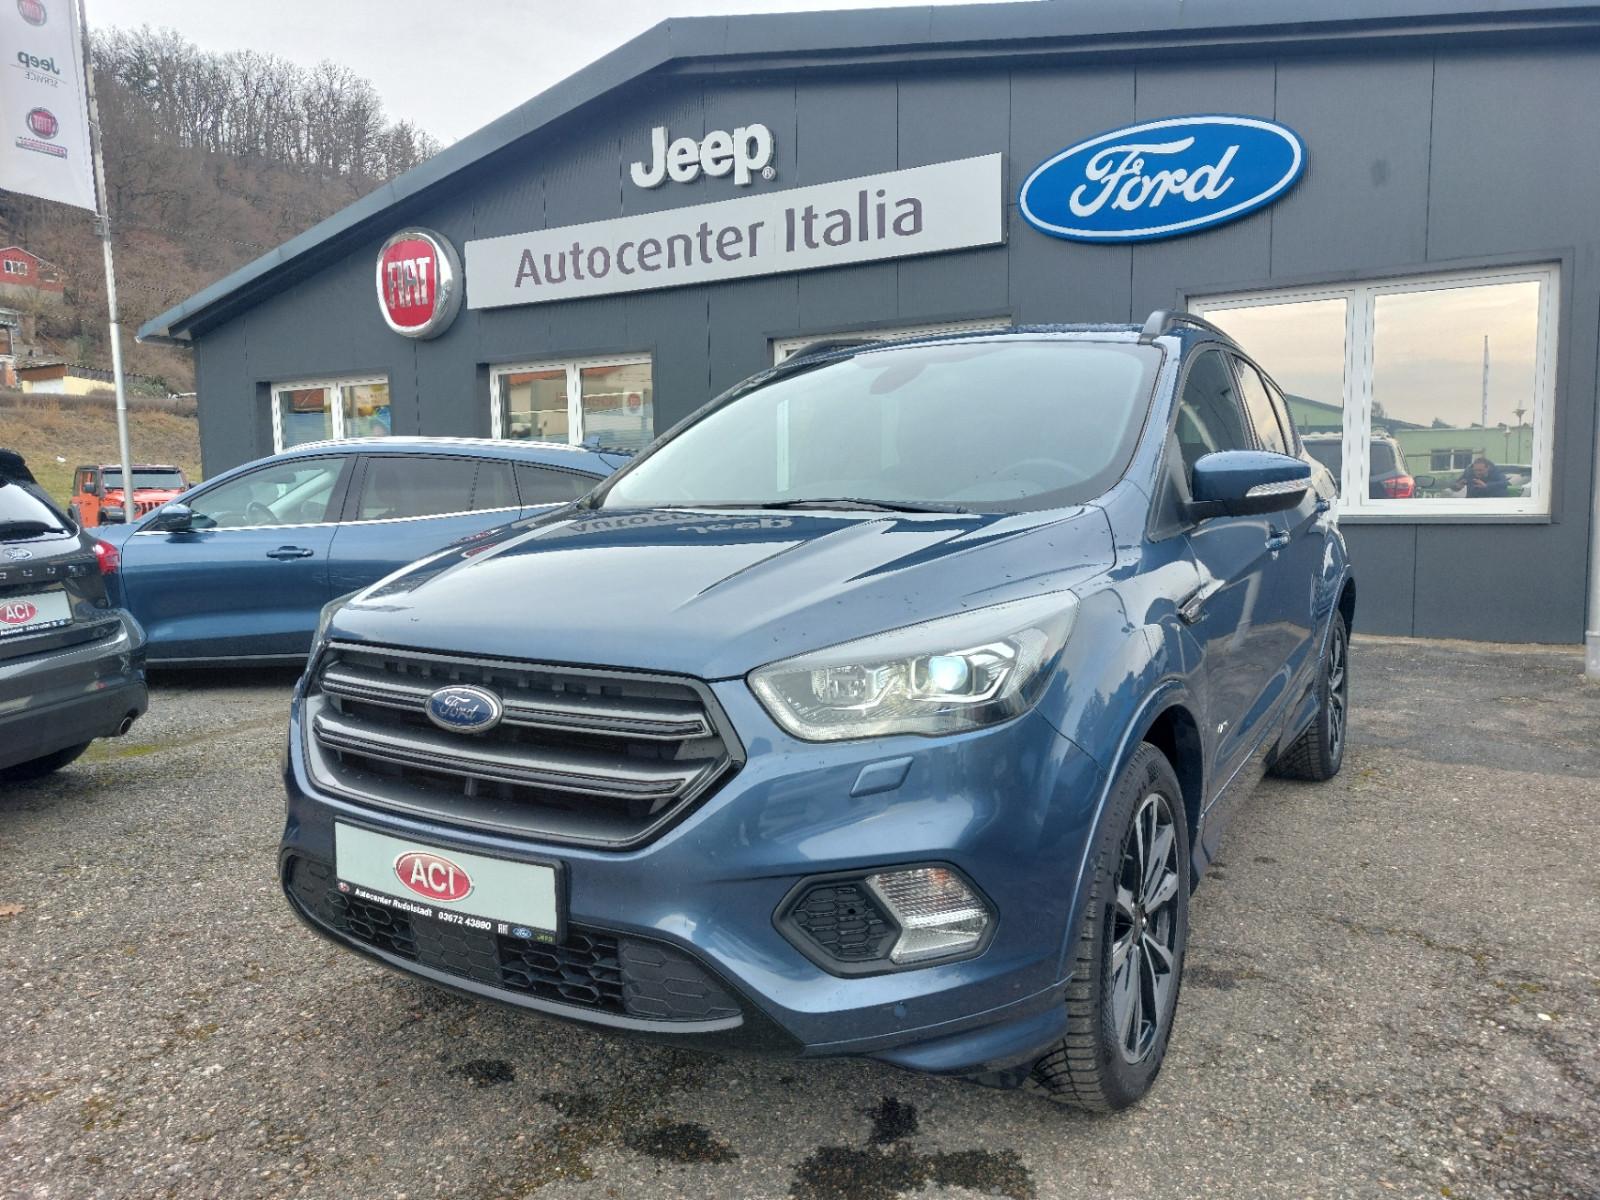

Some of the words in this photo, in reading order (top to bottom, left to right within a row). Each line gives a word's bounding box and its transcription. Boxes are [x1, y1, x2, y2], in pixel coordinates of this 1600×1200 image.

[631, 123, 772, 188] Jeep
[1069, 136, 1240, 217] Ford
[514, 221, 764, 289] Autocenter
[785, 188, 923, 252] Italia
[387, 256, 431, 309] FIAT
[6, 603, 31, 620] ACI
[440, 695, 480, 720] Ford
[410, 858, 455, 896] ACI
[355, 888, 392, 905] Autocenter
[392, 899, 433, 917] Rudolstadt
[438, 911, 464, 925] 03672
